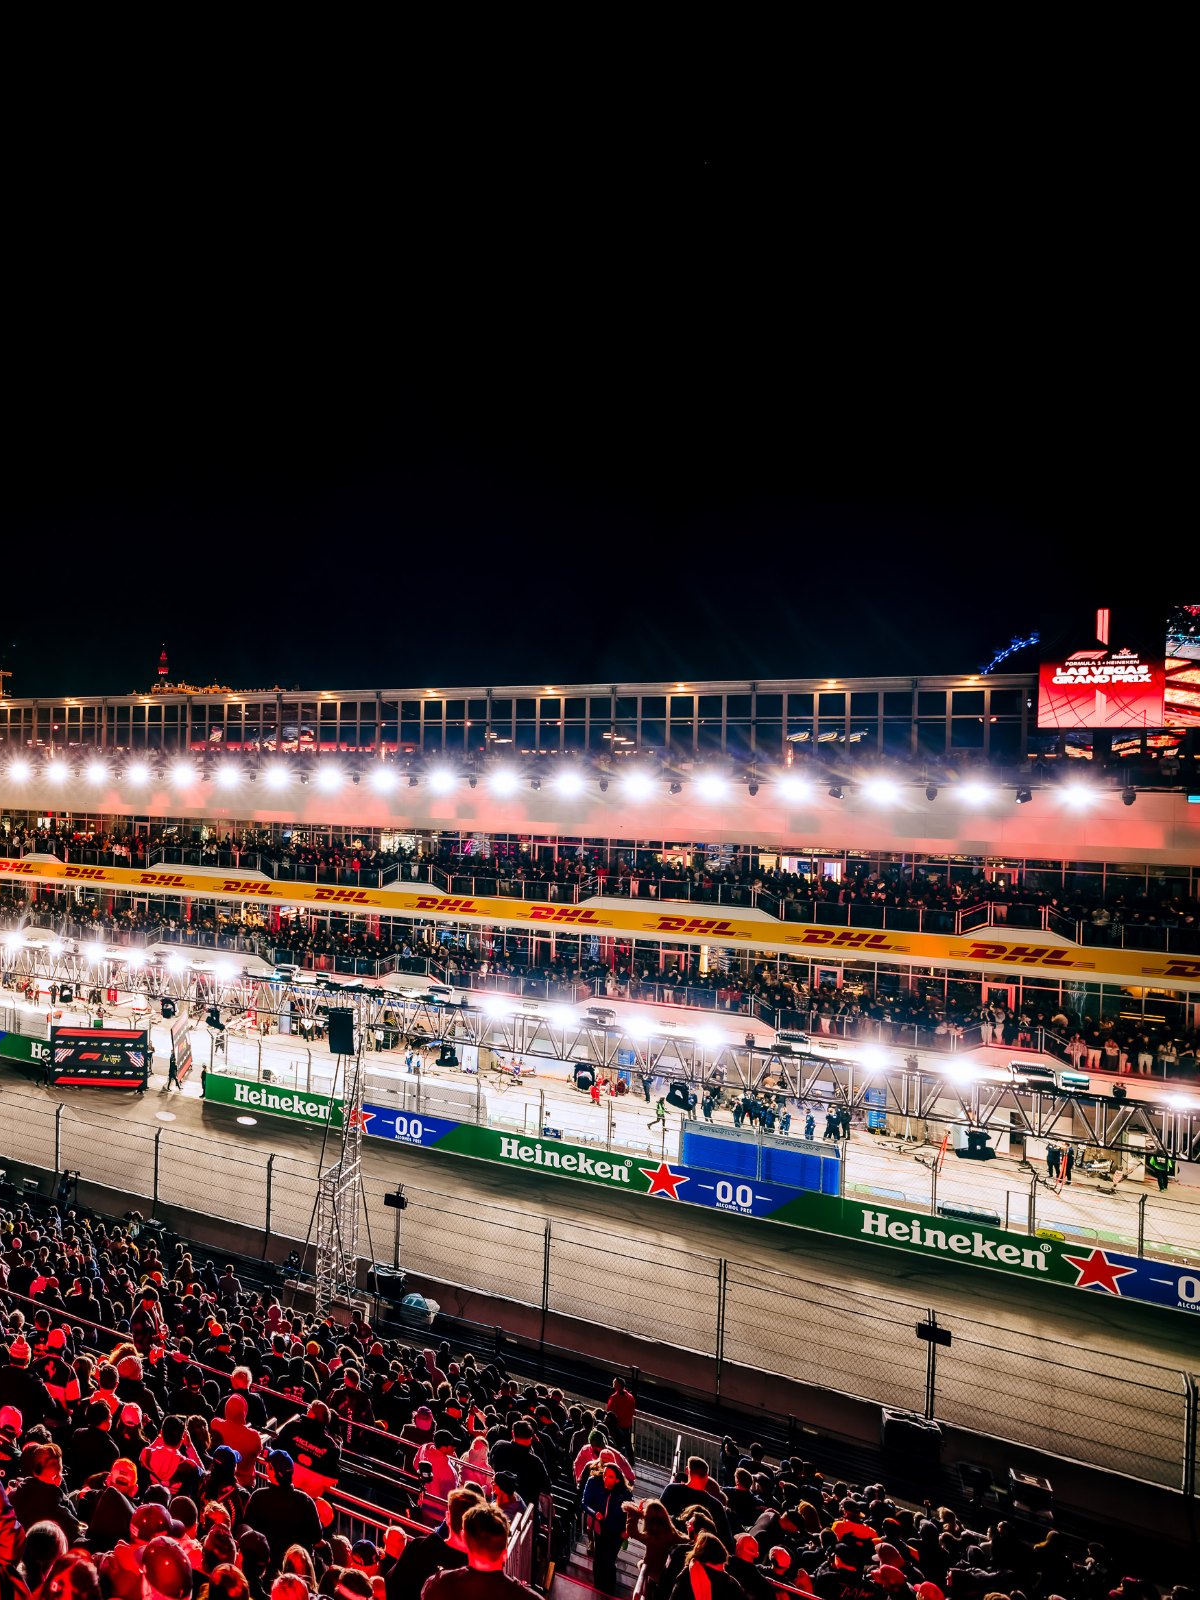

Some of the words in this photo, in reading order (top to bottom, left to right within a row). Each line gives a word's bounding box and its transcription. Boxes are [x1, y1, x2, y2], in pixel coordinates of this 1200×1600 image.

[1052, 675, 1111, 684] GRAND
[1112, 674, 1152, 683] PRIX
[1056, 667, 1089, 676] LAS
[1090, 665, 1149, 675] VEGAS
[64, 867, 106, 880] DHL
[139, 874, 186, 887] DHL
[222, 880, 274, 895] DHL
[314, 888, 371, 904] DHL
[416, 896, 478, 913] DHL
[529, 906, 599, 924] DHL
[657, 916, 736, 936] DHL
[801, 929, 896, 951] DHL
[969, 943, 1076, 967] DHL
[234, 1083, 332, 1120] Heineken
[395, 1116, 422, 1138] 0.0
[716, 1181, 753, 1208] 0.0
[716, 1202, 738, 1212] ALCOHOL
[740, 1206, 752, 1214] FREE
[293, 1436, 324, 1455] McLaren
